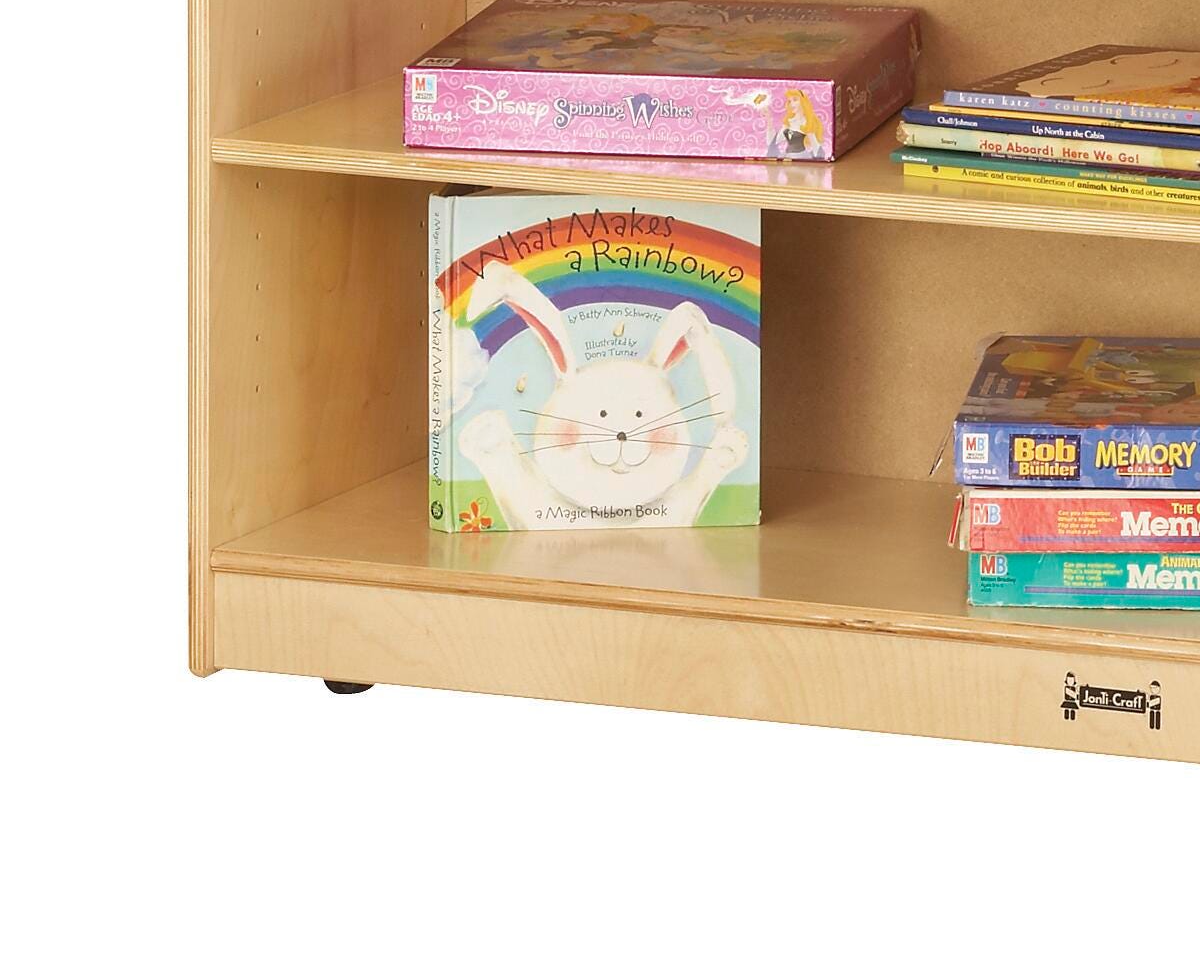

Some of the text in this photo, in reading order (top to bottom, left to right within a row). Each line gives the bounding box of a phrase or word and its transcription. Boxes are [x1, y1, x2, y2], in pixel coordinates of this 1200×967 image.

[412, 105, 433, 113] AGE
[959, 92, 1177, 121] karen katz counting kisses
[412, 113, 441, 122] EDAD
[1031, 125, 1043, 136] Up
[1044, 126, 1065, 137] North
[1065, 129, 1072, 137] at
[1072, 129, 1084, 138] the
[1084, 130, 1105, 141] Cabin
[979, 139, 1002, 153] Hop
[1006, 141, 1054, 157] Aboard!
[1062, 147, 1089, 160] Here
[1093, 149, 1113, 161] We
[1118, 153, 1140, 164] Go!
[962, 168, 969, 176] A
[969, 170, 989, 179] comic
[990, 171, 1005, 180] and
[1006, 173, 1031, 183] curious
[1033, 176, 1066, 187] collection
[1067, 179, 1076, 188] of
[1110, 184, 1129, 194] birds
[1130, 187, 1145, 195] and
[1145, 188, 1164, 197] other
[461, 207, 676, 279] What Makes
[564, 239, 744, 293] a Rainbow?
[567, 307, 662, 324] by Betty Ann Schwartz
[966, 437, 985, 451] MB
[1013, 437, 1077, 462] Bob
[1095, 440, 1197, 469] MEMORY
[1018, 462, 1078, 477] Builder
[1127, 465, 1164, 474] GAME
[535, 504, 669, 522] a Magic Ribbon Book
[973, 503, 1001, 525] MB
[1171, 502, 1194, 515] THE
[980, 554, 1008, 576] MB
